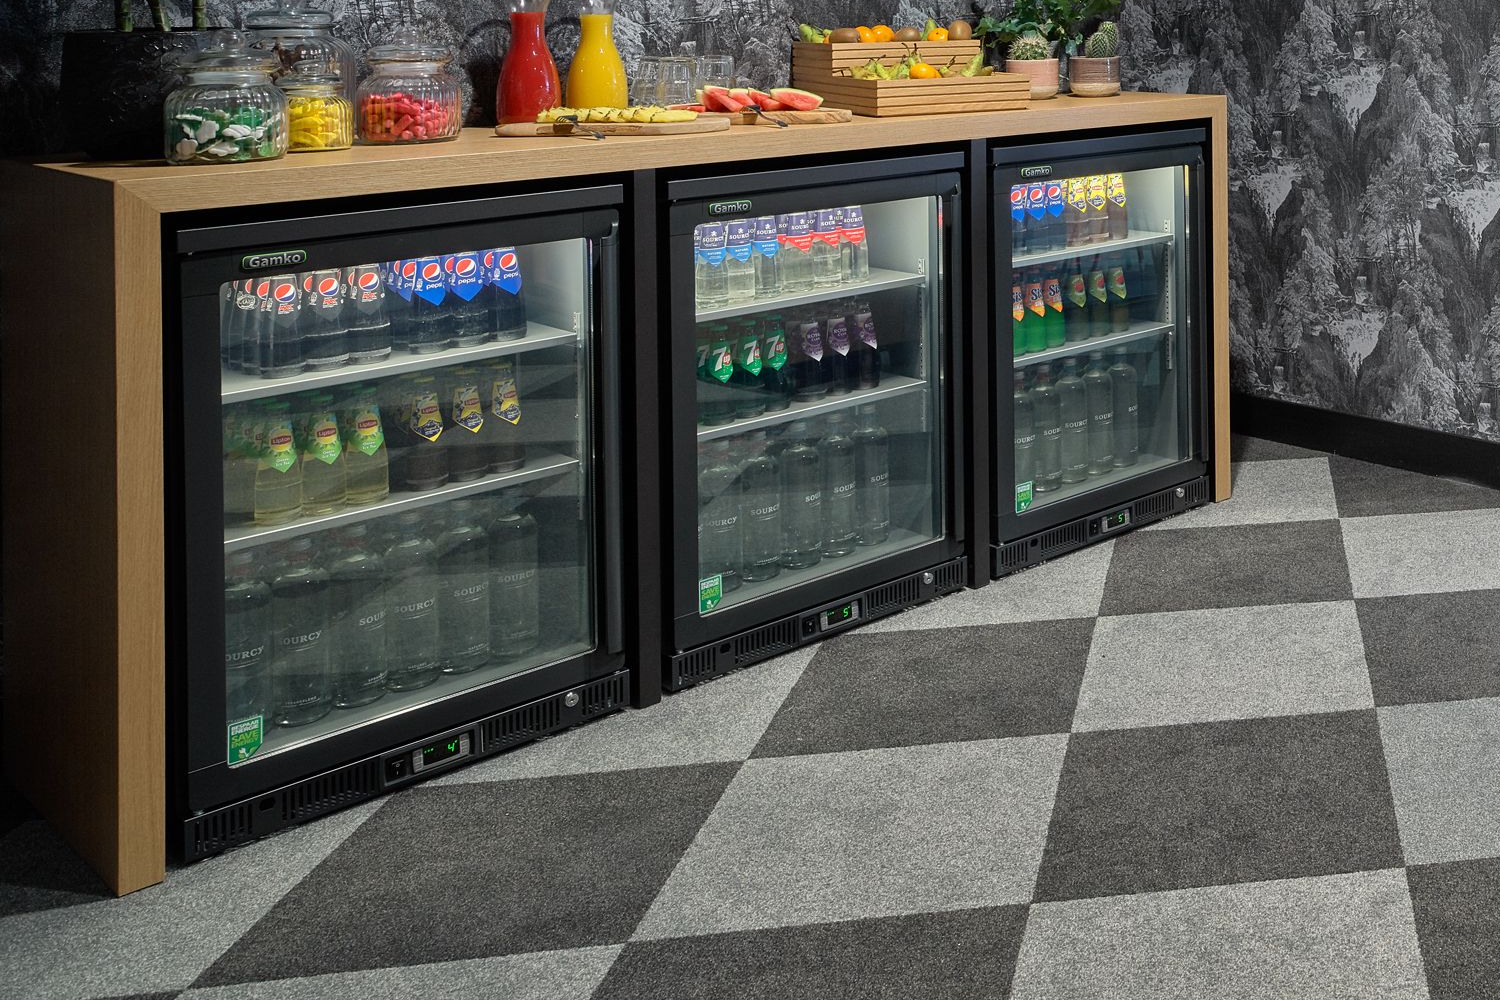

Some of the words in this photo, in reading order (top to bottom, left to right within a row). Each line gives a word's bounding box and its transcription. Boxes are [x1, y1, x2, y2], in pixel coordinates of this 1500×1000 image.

[1025, 168, 1049, 176] Gamko
[714, 202, 748, 213] Gamko
[249, 253, 301, 268] Gamko
[458, 277, 476, 285] pepsi
[281, 630, 322, 646] OURCY
[232, 730, 259, 742] SAVE
